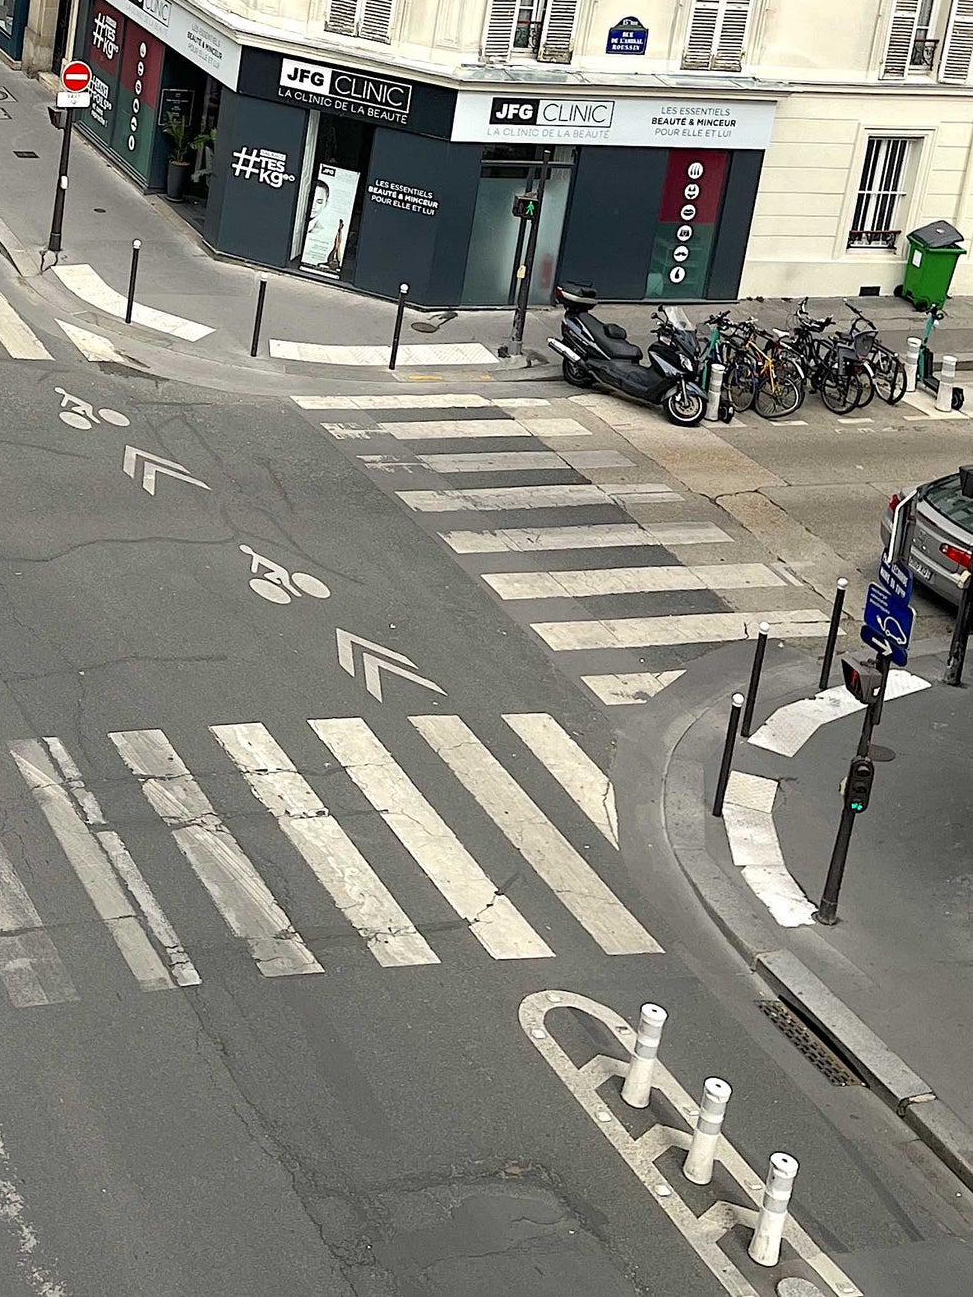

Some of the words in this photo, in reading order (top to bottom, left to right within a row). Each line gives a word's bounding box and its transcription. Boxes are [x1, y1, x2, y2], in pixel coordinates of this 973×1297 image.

[287, 67, 324, 86] JFG
[335, 75, 404, 106] CLINIC
[278, 87, 292, 98] LA
[294, 91, 332, 107] CLINIC
[334, 100, 348, 111] DE
[350, 104, 365, 115] LA
[496, 103, 534, 120] JFG
[543, 103, 608, 123] CLINIC
[661, 106, 678, 115] LES
[679, 107, 731, 117] ESSENTIELS
[651, 116, 687, 126] BEAUTÉ
[688, 118, 694, 126] &
[696, 119, 737, 127] MINCEUR
[487, 128, 500, 136] LA
[503, 128, 539, 137] CLINIC
[542, 129, 555, 137] DE
[557, 129, 571, 138] LA
[654, 127, 680, 136] POUR
[682, 128, 703, 137] ELLE
[705, 129, 716, 137] ET
[717, 130, 732, 138] LUI
[259, 156, 286, 172] TES
[375, 179, 389, 188] LES
[390, 183, 433, 199] ESSENTIELS
[371, 194, 392, 206] POUR
[392, 200, 411, 210] ELLE
[412, 204, 422, 212] ET
[422, 207, 435, 216] LUI
[404, 194, 439, 209] MINCEUR
